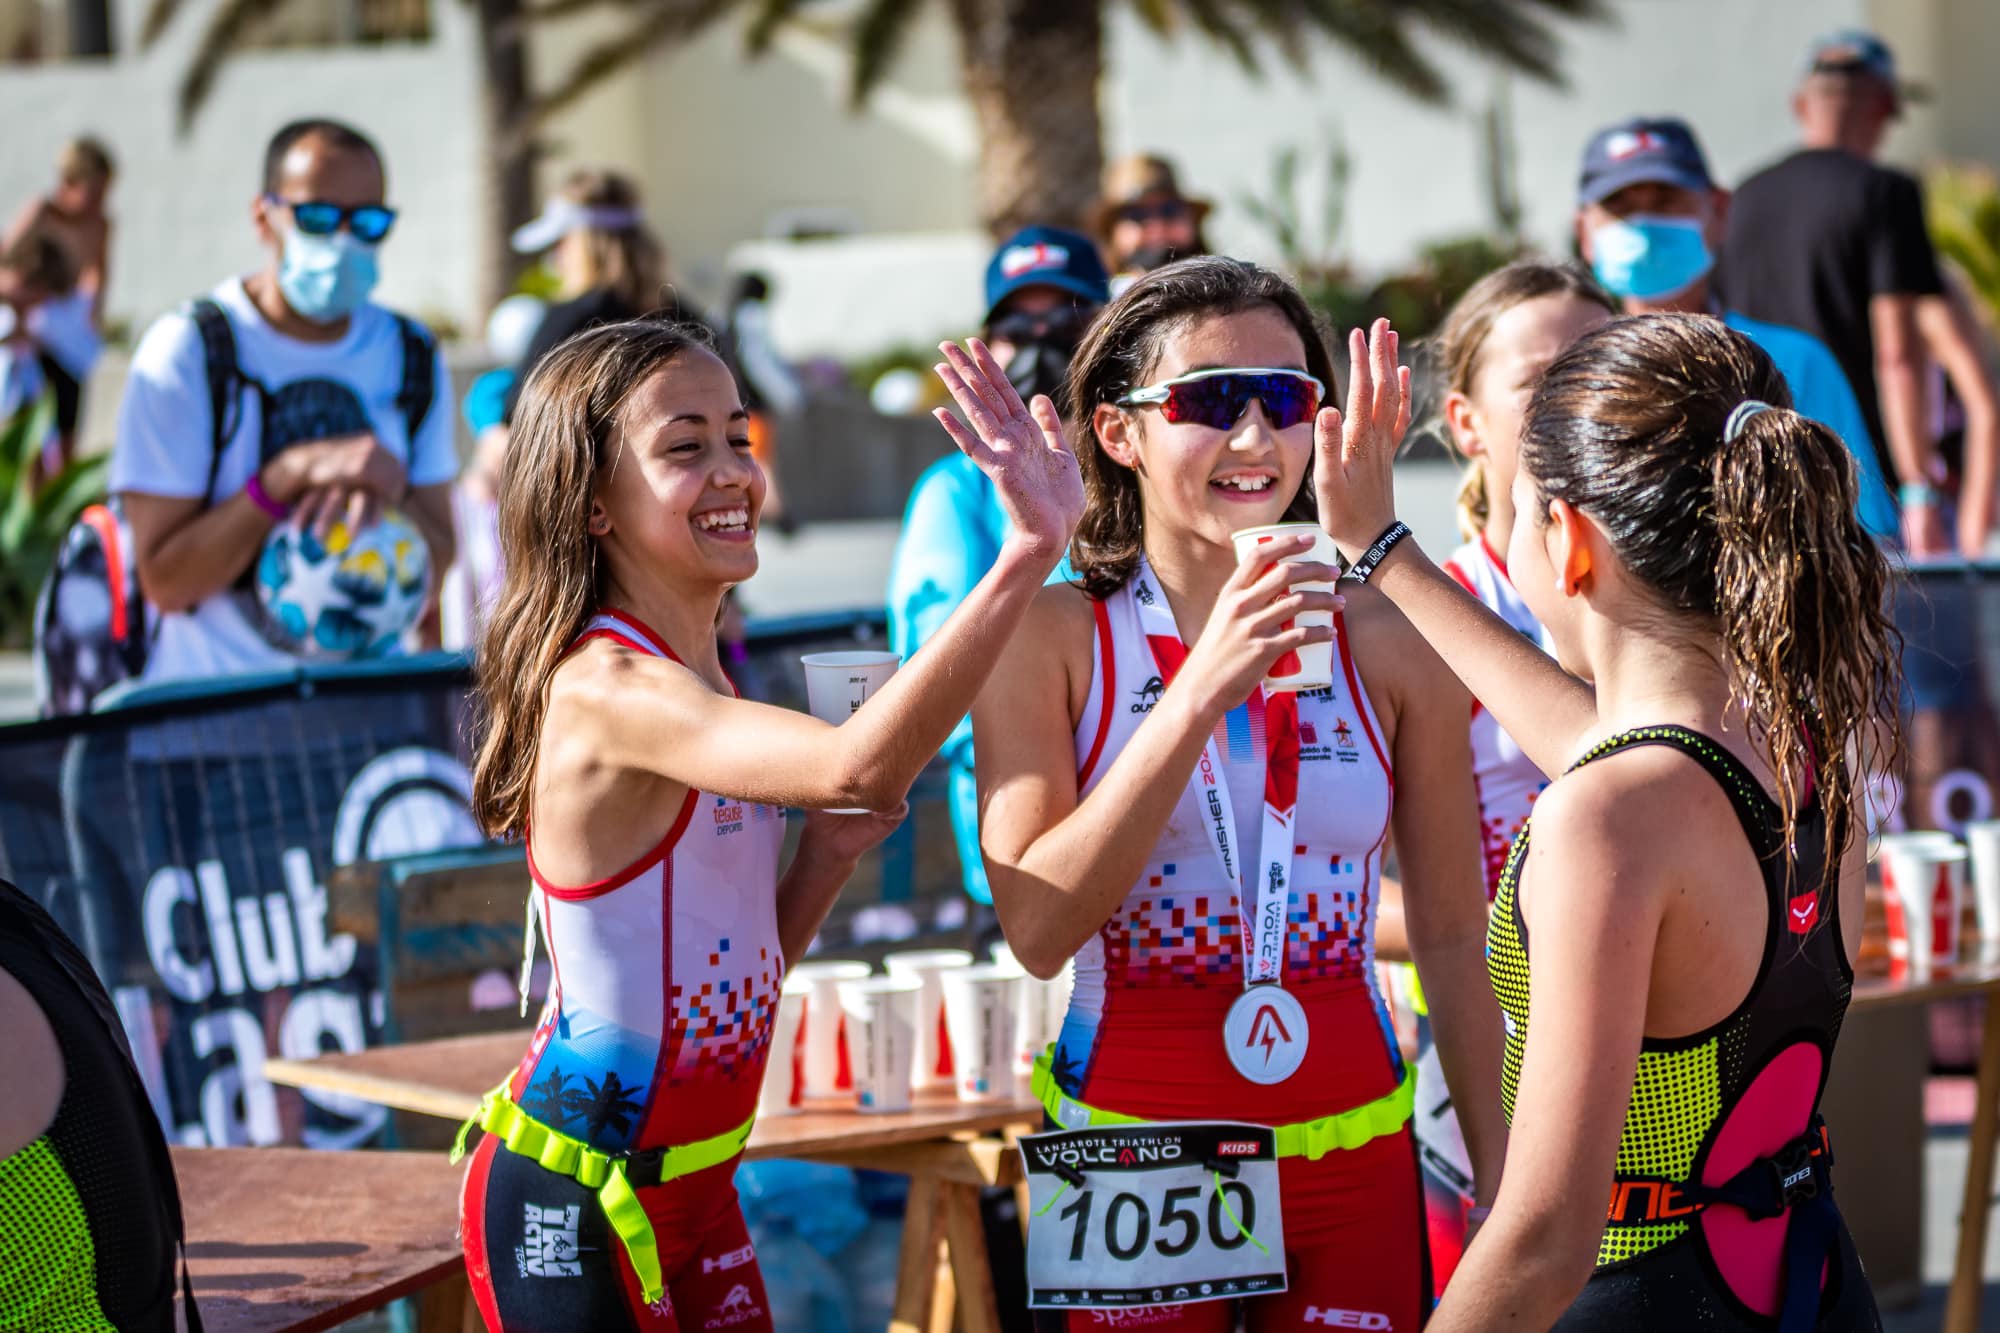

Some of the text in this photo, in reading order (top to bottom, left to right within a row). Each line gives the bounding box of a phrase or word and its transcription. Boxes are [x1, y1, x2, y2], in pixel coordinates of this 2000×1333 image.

[1206, 788, 1236, 879] FINISHER
[1036, 1136, 1182, 1154] LANZAROTE TRIATHLON
[1037, 1143, 1258, 1167] VOLCANO KIDS
[524, 1203, 544, 1277] ACTIV
[542, 1204, 583, 1278] TRI
[1060, 1181, 1256, 1262] 1050
